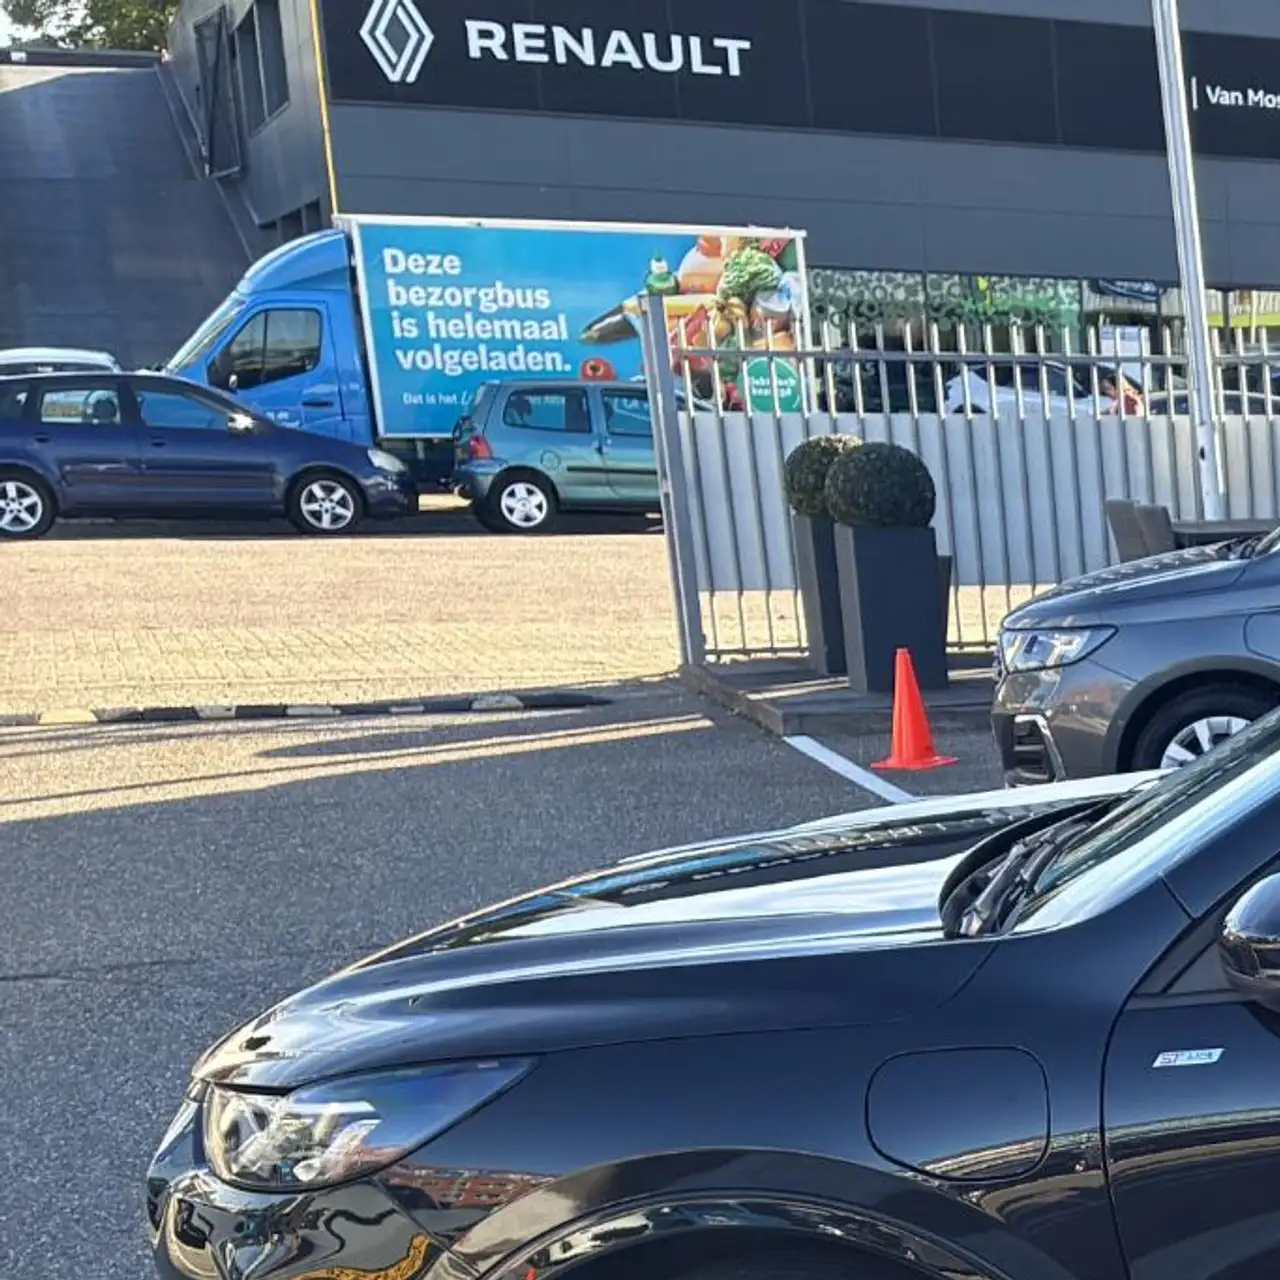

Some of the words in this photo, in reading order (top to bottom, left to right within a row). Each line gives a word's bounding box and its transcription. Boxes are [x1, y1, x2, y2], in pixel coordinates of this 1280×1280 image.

[465, 20, 751, 76] RENAULT
[1206, 84, 1243, 106] Van
[383, 248, 462, 275] Deze
[387, 279, 550, 313] bezorgbus
[392, 311, 418, 339] is
[427, 311, 568, 341] helemaal
[396, 343, 572, 376] volgeladen.
